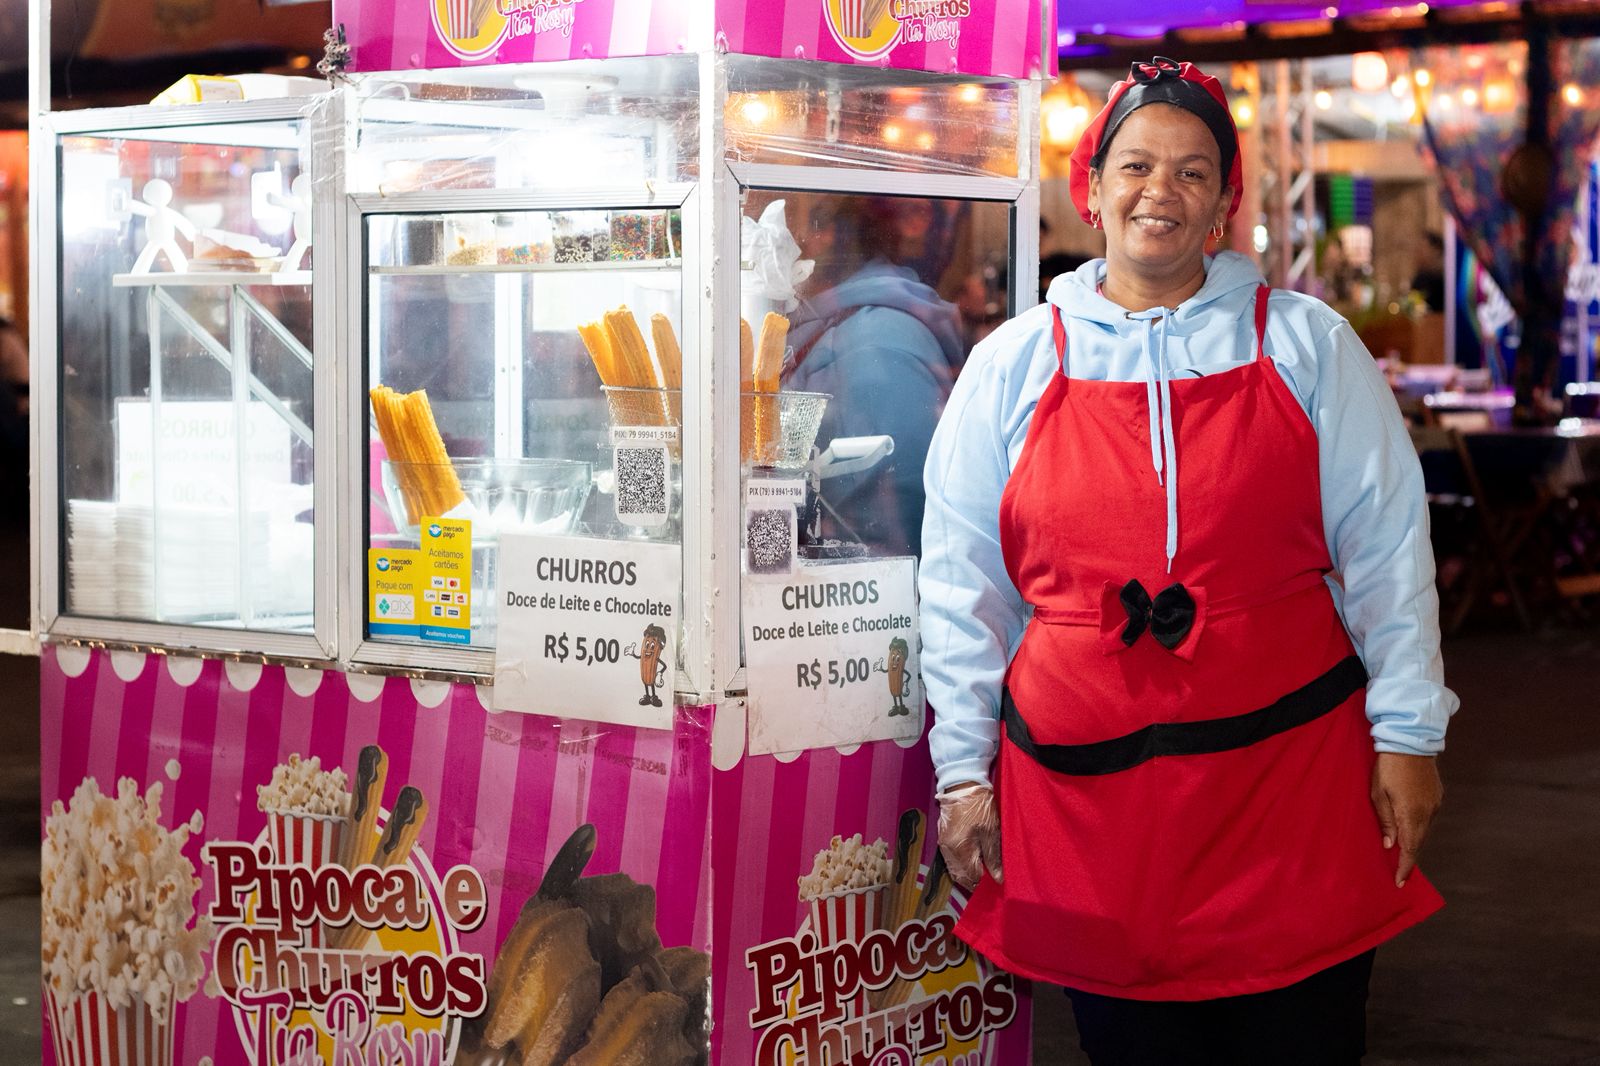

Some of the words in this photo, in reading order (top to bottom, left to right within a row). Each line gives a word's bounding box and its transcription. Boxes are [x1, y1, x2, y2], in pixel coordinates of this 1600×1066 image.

[504, 8, 532, 39] Tia
[532, 4, 574, 38] Rosy
[897, 14, 923, 45] Tia
[923, 12, 960, 49] Rosy
[628, 430, 637, 439] 79
[749, 487, 759, 496] PIX
[443, 525, 464, 533] mercado
[391, 565, 404, 573] pago
[429, 548, 464, 560] Aceitamos
[434, 560, 459, 570] cartões
[376, 580, 397, 590] Pague
[398, 581, 414, 590] com
[536, 557, 637, 586] CHURROS
[507, 591, 537, 608] Doce
[540, 592, 556, 609] de
[559, 594, 590, 611] Leite
[593, 600, 601, 612] e
[605, 597, 672, 617] Chocolate
[782, 580, 879, 611] CHURROS
[752, 625, 785, 641] Doce
[788, 622, 804, 638] de
[808, 620, 839, 636] Leite
[842, 622, 849, 633] e
[852, 614, 912, 633] Chocolate
[544, 632, 569, 663] R$
[575, 637, 620, 666] 5,00
[797, 658, 822, 690] R$
[828, 658, 870, 688] 5,00
[204, 841, 429, 946] Pipoca
[443, 865, 486, 931] e
[215, 925, 487, 1017] Churros
[746, 911, 966, 1027] Pipoca
[237, 988, 323, 1066] Tia
[756, 972, 1016, 1066] Churros
